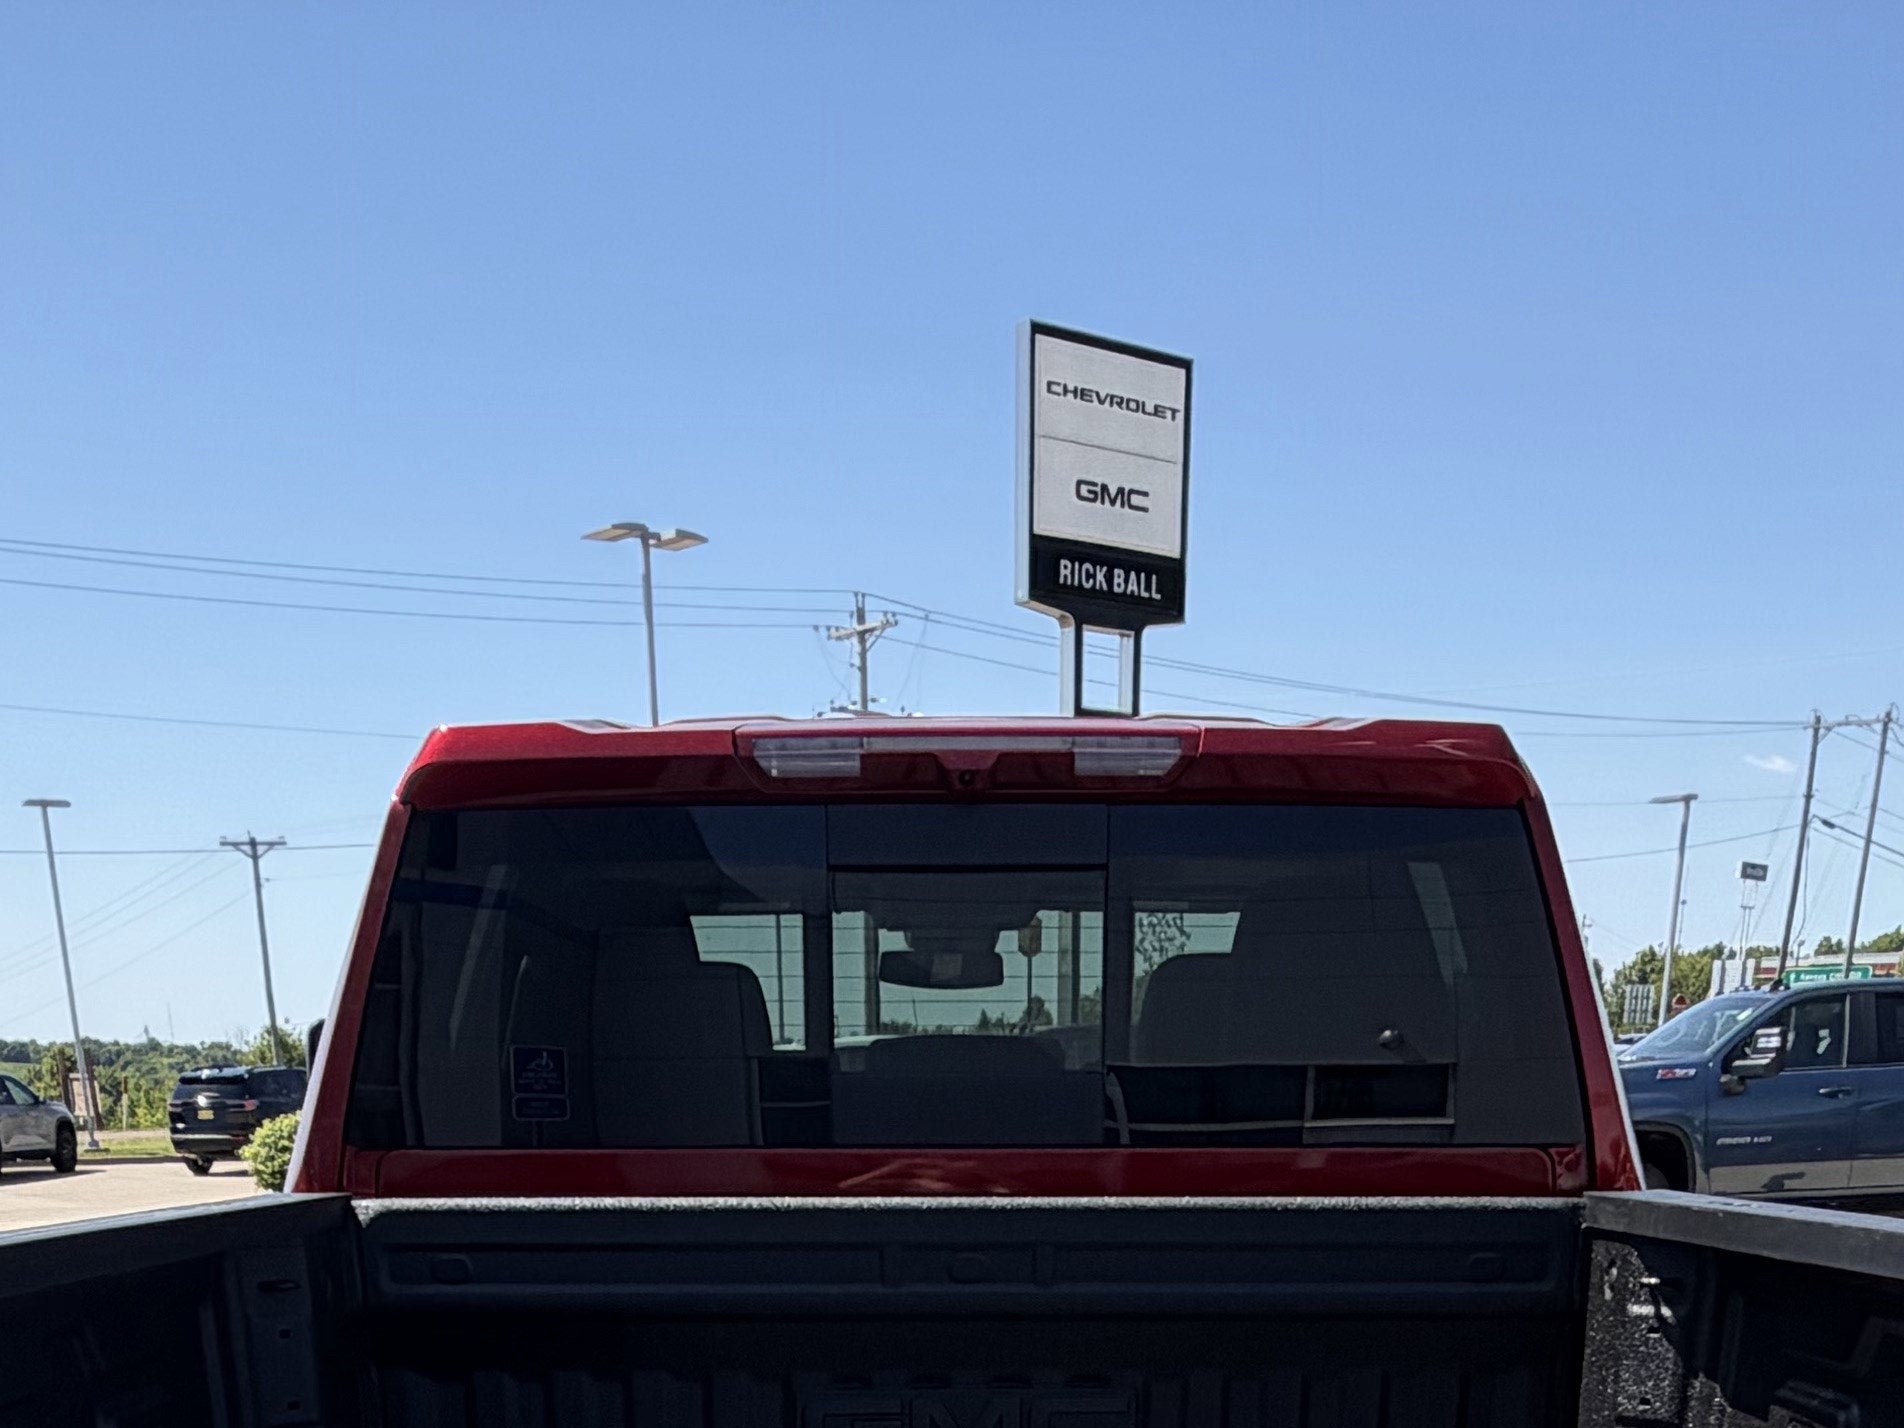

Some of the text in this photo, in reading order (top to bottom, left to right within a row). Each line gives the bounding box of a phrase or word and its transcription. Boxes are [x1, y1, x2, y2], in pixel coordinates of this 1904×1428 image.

[1046, 380, 1180, 422] CHEVROLET
[1075, 479, 1149, 512] GMC
[1059, 558, 1162, 600] RICK BALL
